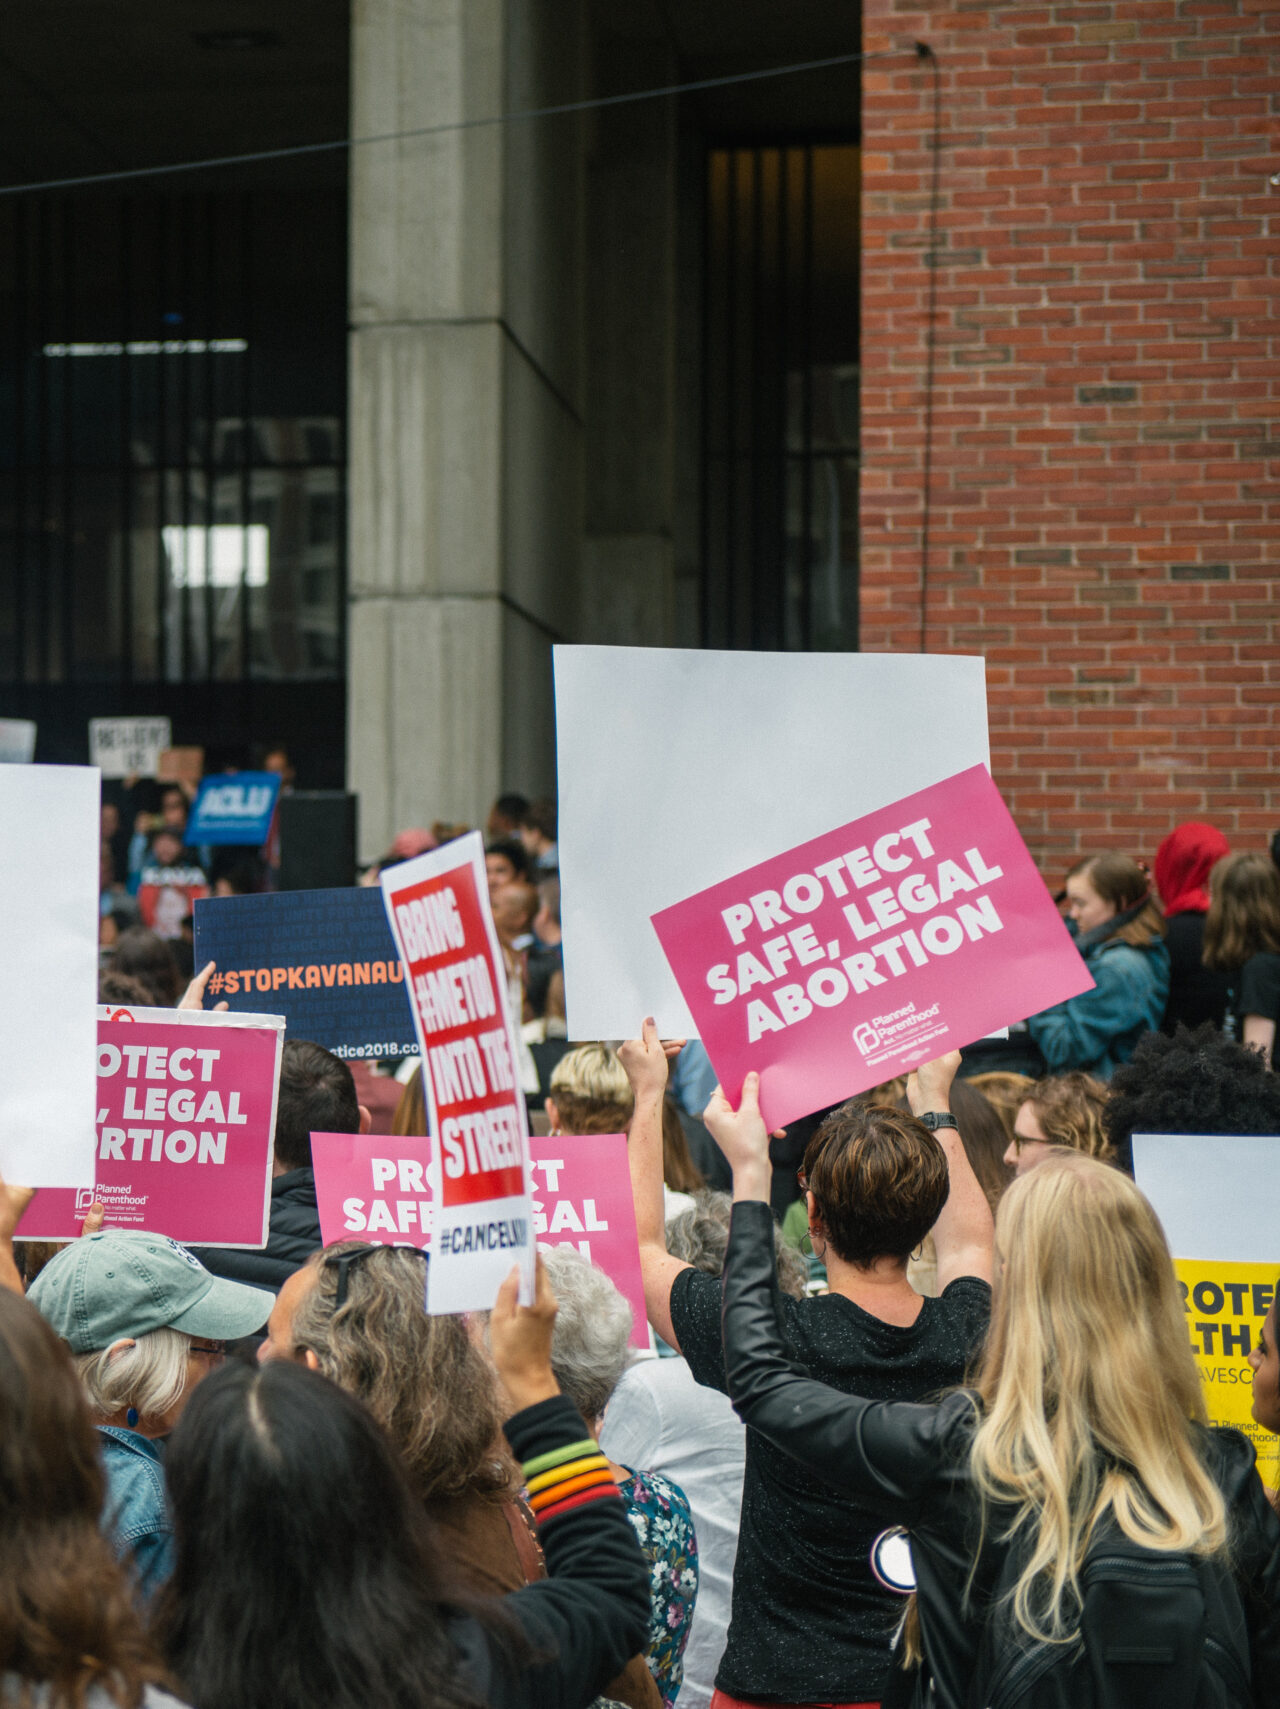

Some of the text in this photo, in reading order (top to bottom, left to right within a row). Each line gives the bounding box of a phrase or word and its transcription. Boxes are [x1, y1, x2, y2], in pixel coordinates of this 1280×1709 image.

[196, 783, 274, 818] ACLU
[721, 817, 936, 945] PROTECT
[395, 886, 466, 964] BRING
[706, 848, 1004, 1006] SAFE, LEGAL
[746, 895, 1005, 1044] ABORTION
[872, 1001, 916, 1028] Planned
[877, 1006, 940, 1039] Parenthood
[429, 1034, 488, 1107] INTO
[123, 1086, 248, 1125] LEGAL
[94, 1194, 147, 1205] Parenthood
[95, 1184, 132, 1194] Planned
[1222, 1420, 1259, 1431] Planned
